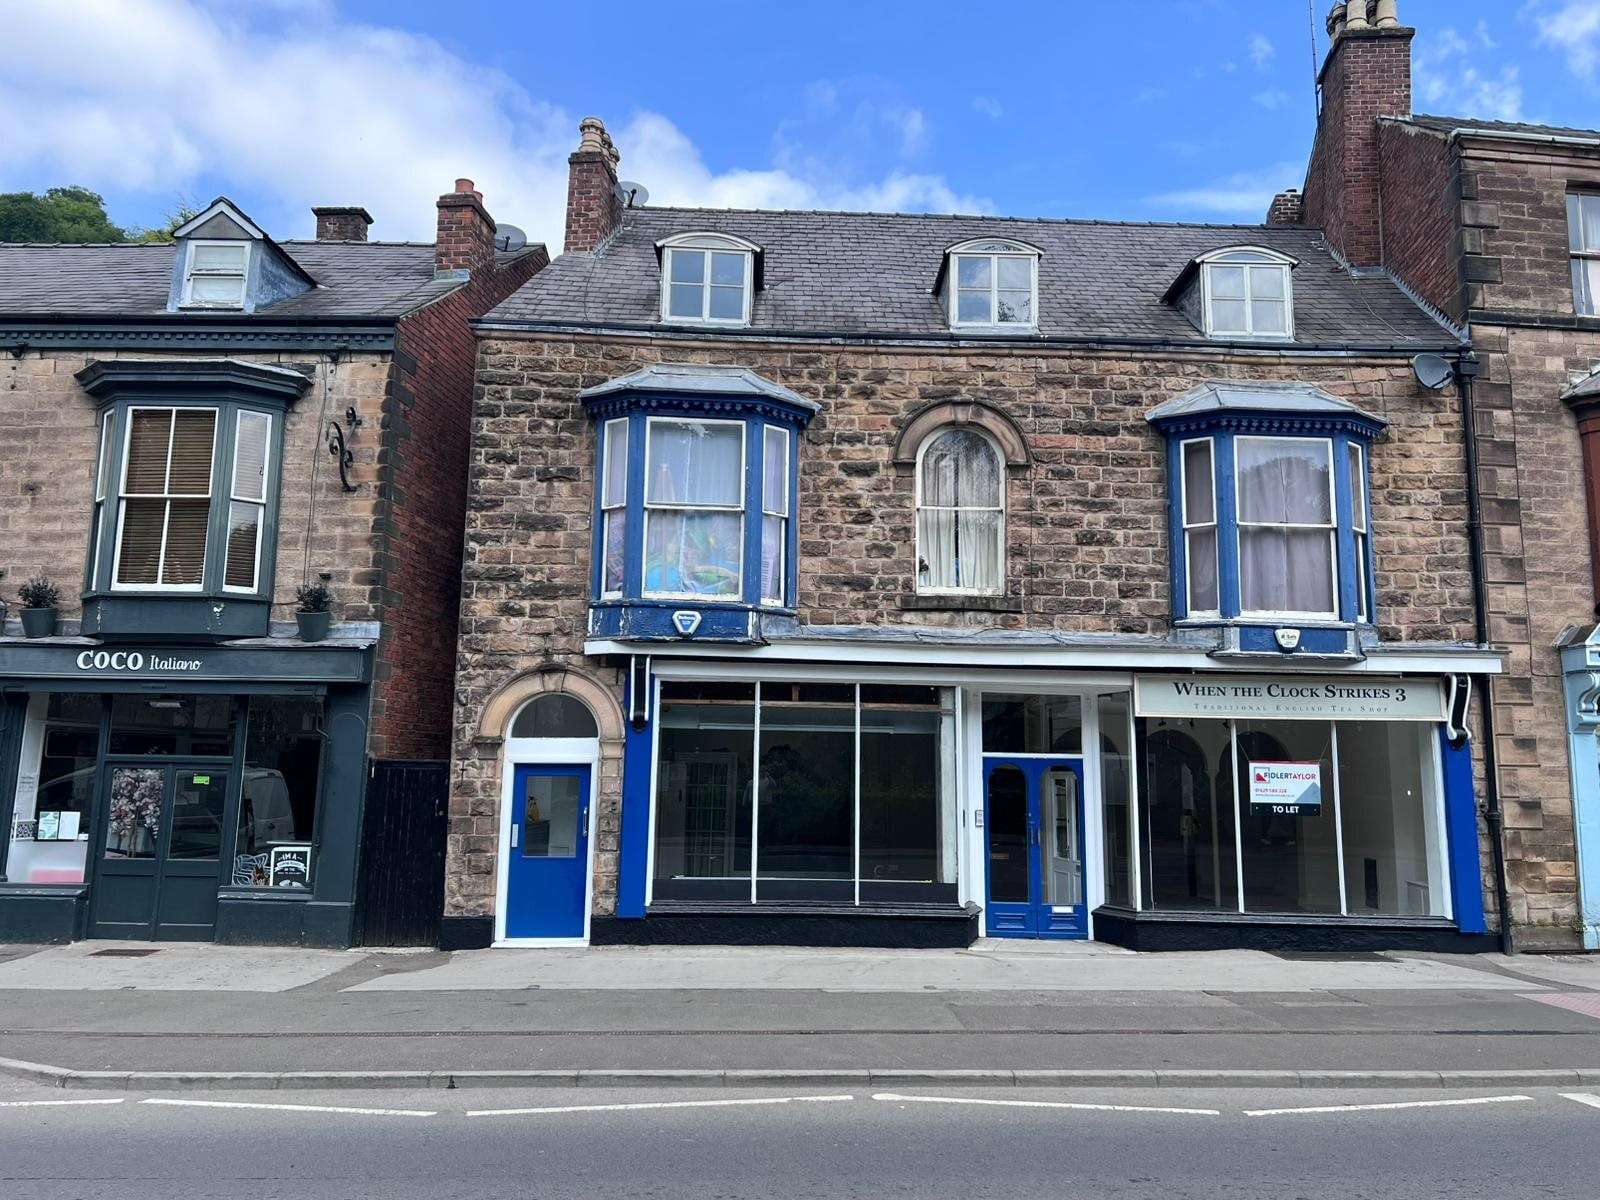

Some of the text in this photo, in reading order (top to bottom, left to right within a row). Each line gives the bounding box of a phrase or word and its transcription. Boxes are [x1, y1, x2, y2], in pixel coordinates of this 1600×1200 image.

[77, 650, 203, 671] COCO Italiano
[1173, 682, 1407, 702] WHEN THE CLOCK STRIKES 3
[1193, 703, 1267, 711] TRADITIONAL
[1272, 805, 1299, 814] TO LET
